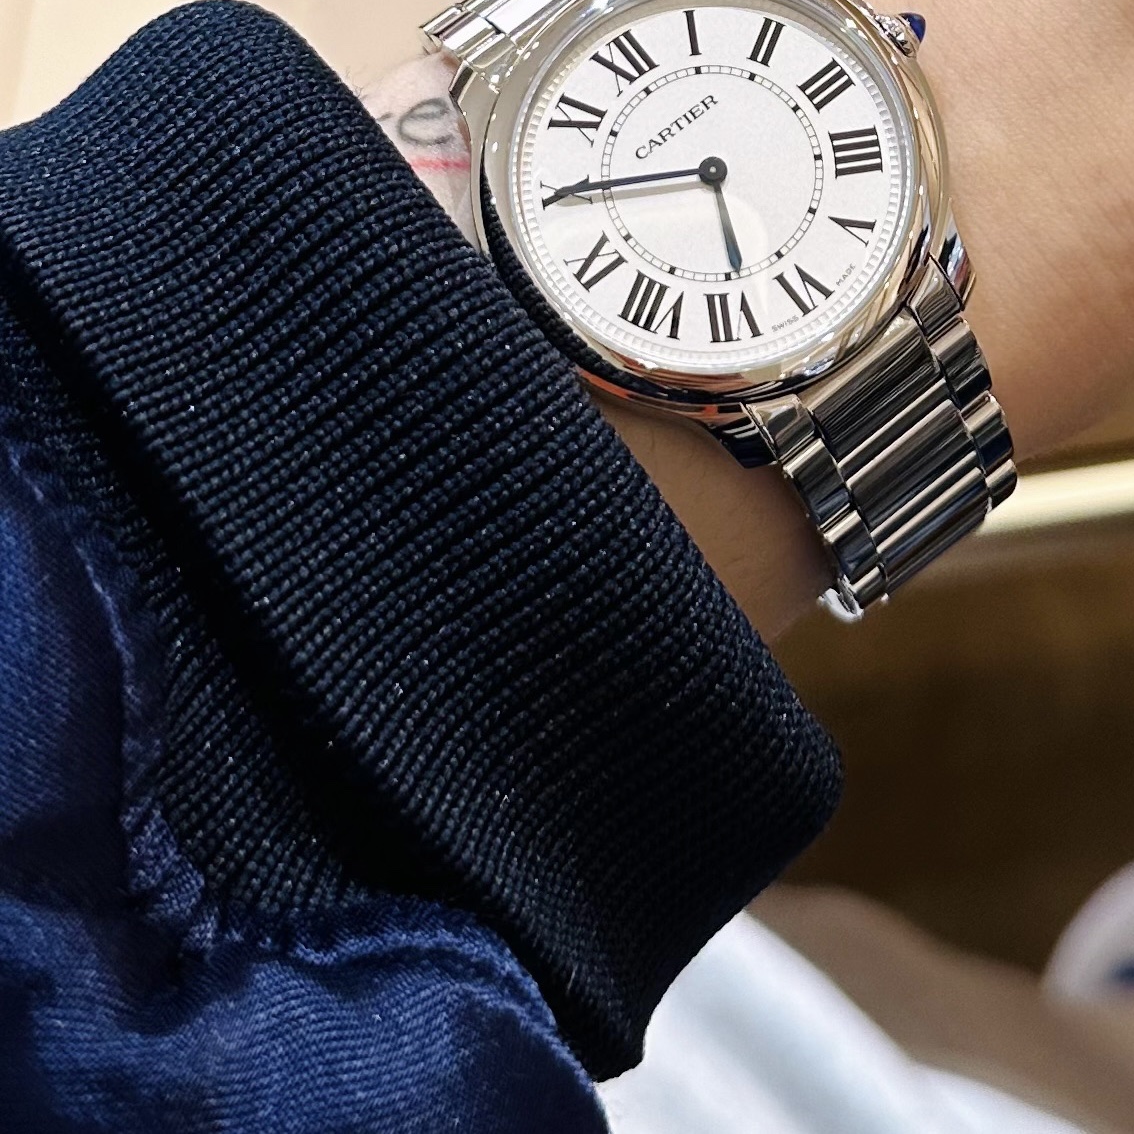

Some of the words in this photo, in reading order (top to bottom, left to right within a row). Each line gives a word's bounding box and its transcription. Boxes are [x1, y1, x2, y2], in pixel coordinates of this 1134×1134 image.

[589, 29, 660, 97] XII
[746, 17, 786, 67] II
[796, 57, 856, 114] III
[547, 92, 608, 148] XI
[635, 95, 718, 159] CARTIER
[828, 125, 883, 179] IIII
[827, 216, 877, 247] V
[563, 230, 628, 293] IX
[617, 269, 684, 340] VIII
[703, 290, 764, 343] VII
[771, 314, 799, 332] SWISS
[835, 263, 856, 286] MADE
[772, 263, 835, 317] VI
